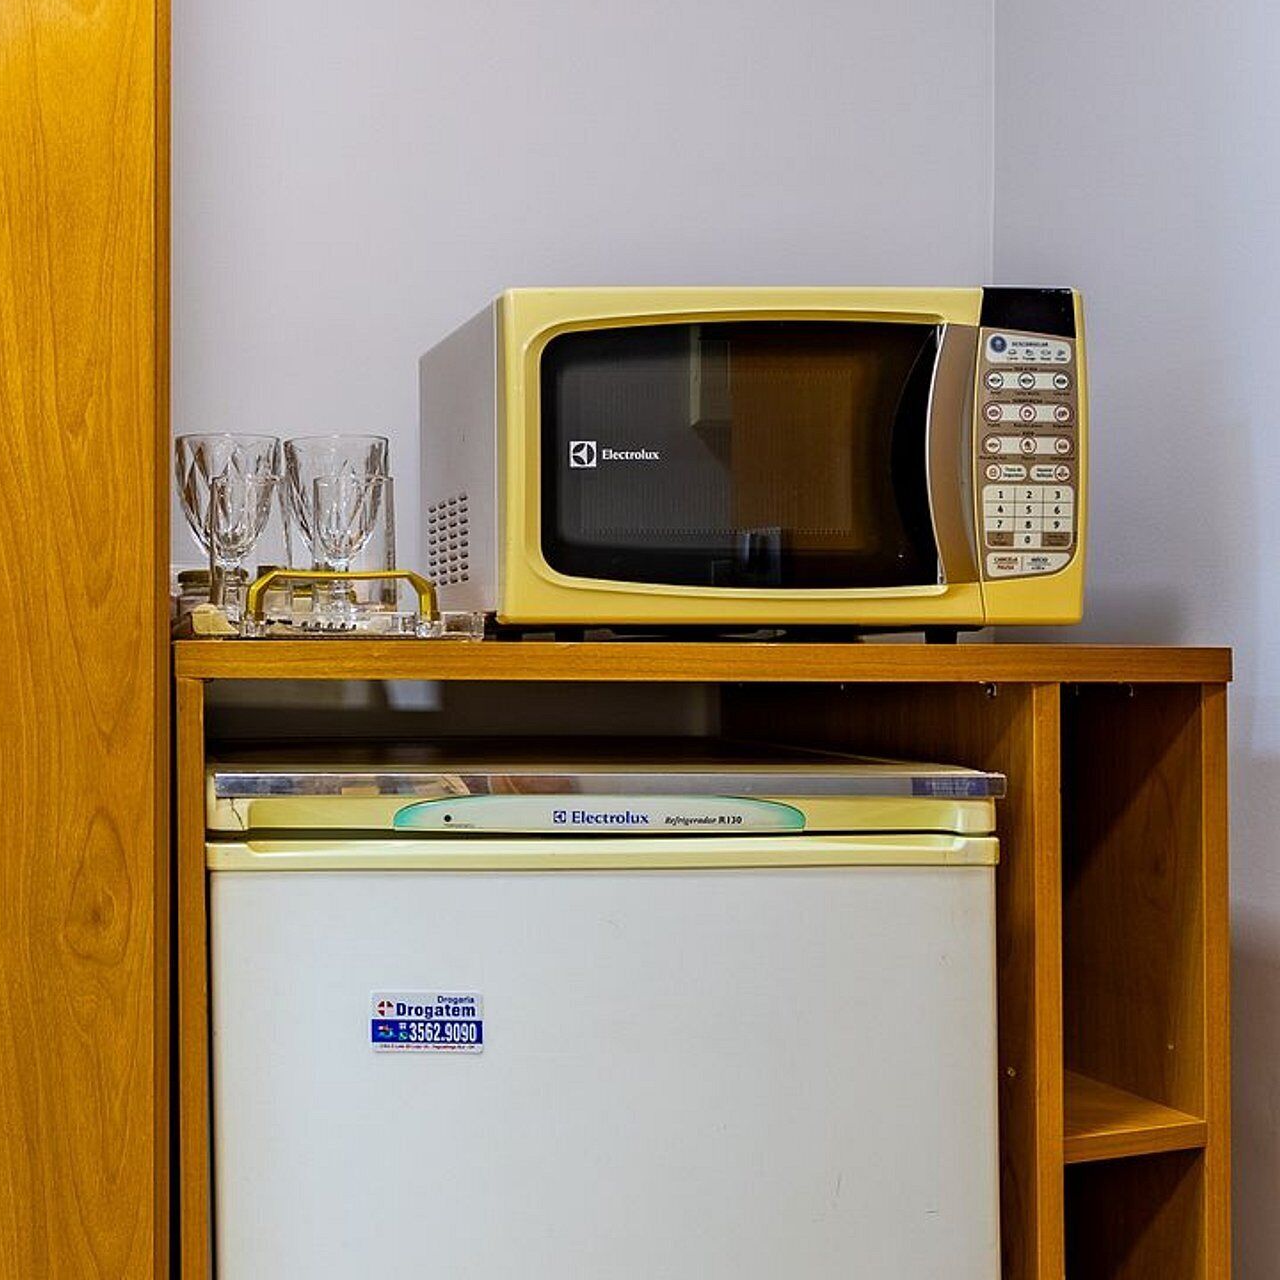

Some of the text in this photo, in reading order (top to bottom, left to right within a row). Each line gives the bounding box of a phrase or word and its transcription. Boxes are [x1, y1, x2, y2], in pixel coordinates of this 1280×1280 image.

[602, 448, 660, 460] Electrolux
[998, 490, 1061, 499] 1 2 3
[997, 505, 1061, 514] 4 5 6
[997, 520, 1060, 529] 7 8 9
[1024, 535, 1031, 544] 0
[572, 811, 649, 824] Electrolux
[665, 816, 717, 826] Refrigerador
[437, 995, 475, 1004] Drogaria
[396, 1002, 476, 1019] Drogatem
[409, 1022, 477, 1042] 3562.9090
